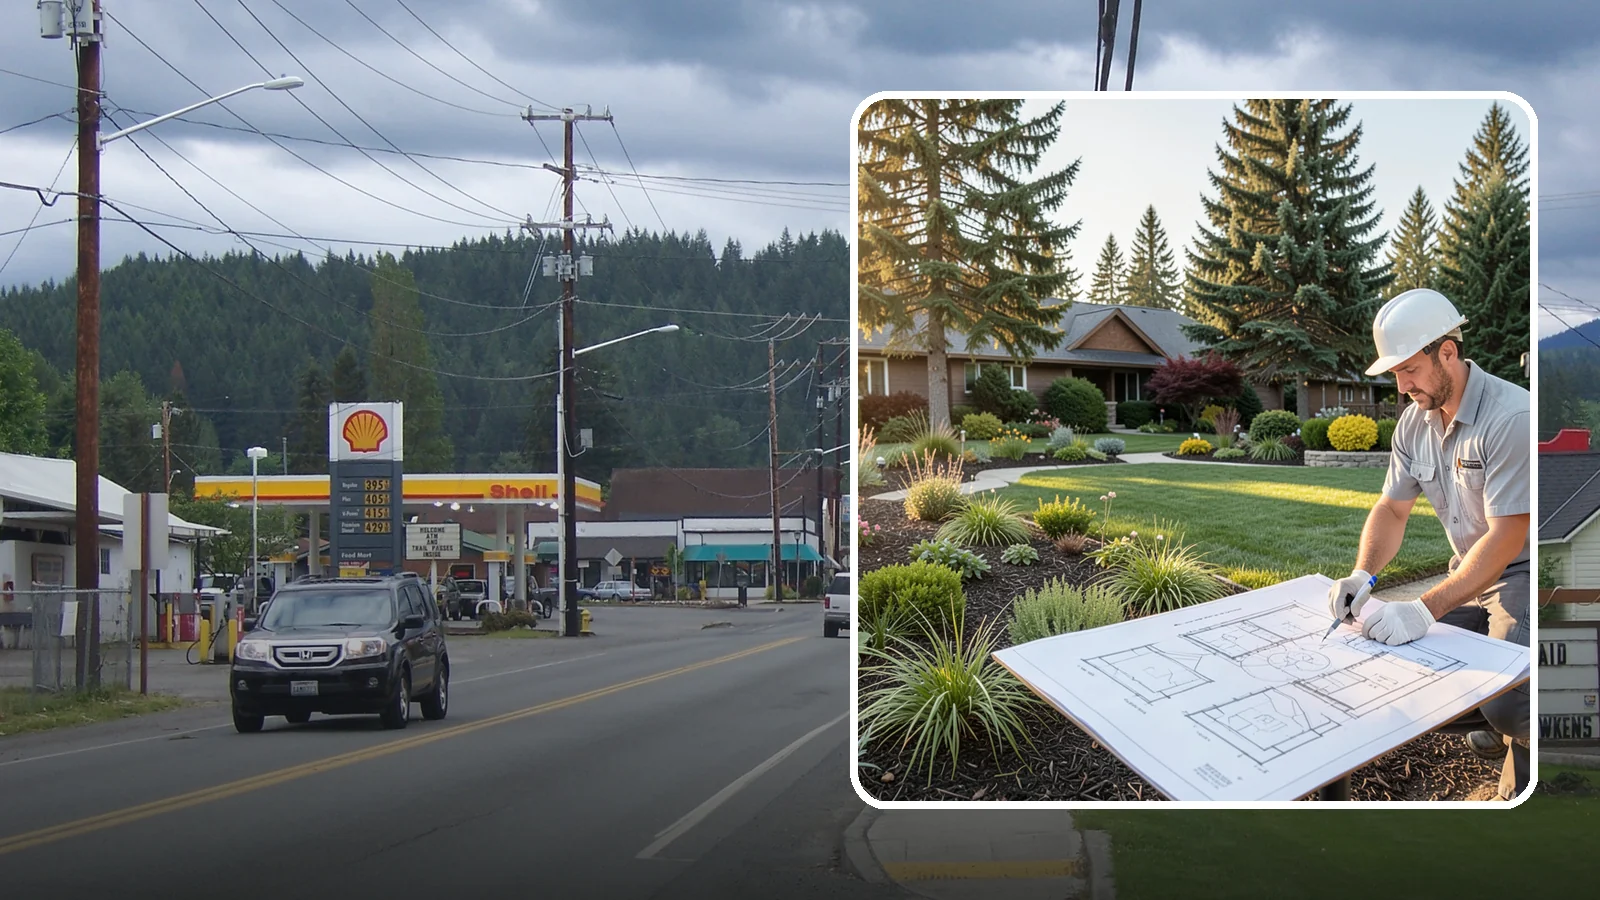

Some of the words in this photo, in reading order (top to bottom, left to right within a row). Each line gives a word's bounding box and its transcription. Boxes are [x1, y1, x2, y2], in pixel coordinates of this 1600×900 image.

[366, 480, 384, 490] 395
[490, 484, 547, 499] Shell
[366, 494, 384, 504] 405
[366, 508, 384, 518] 415
[366, 522, 384, 532] 429
